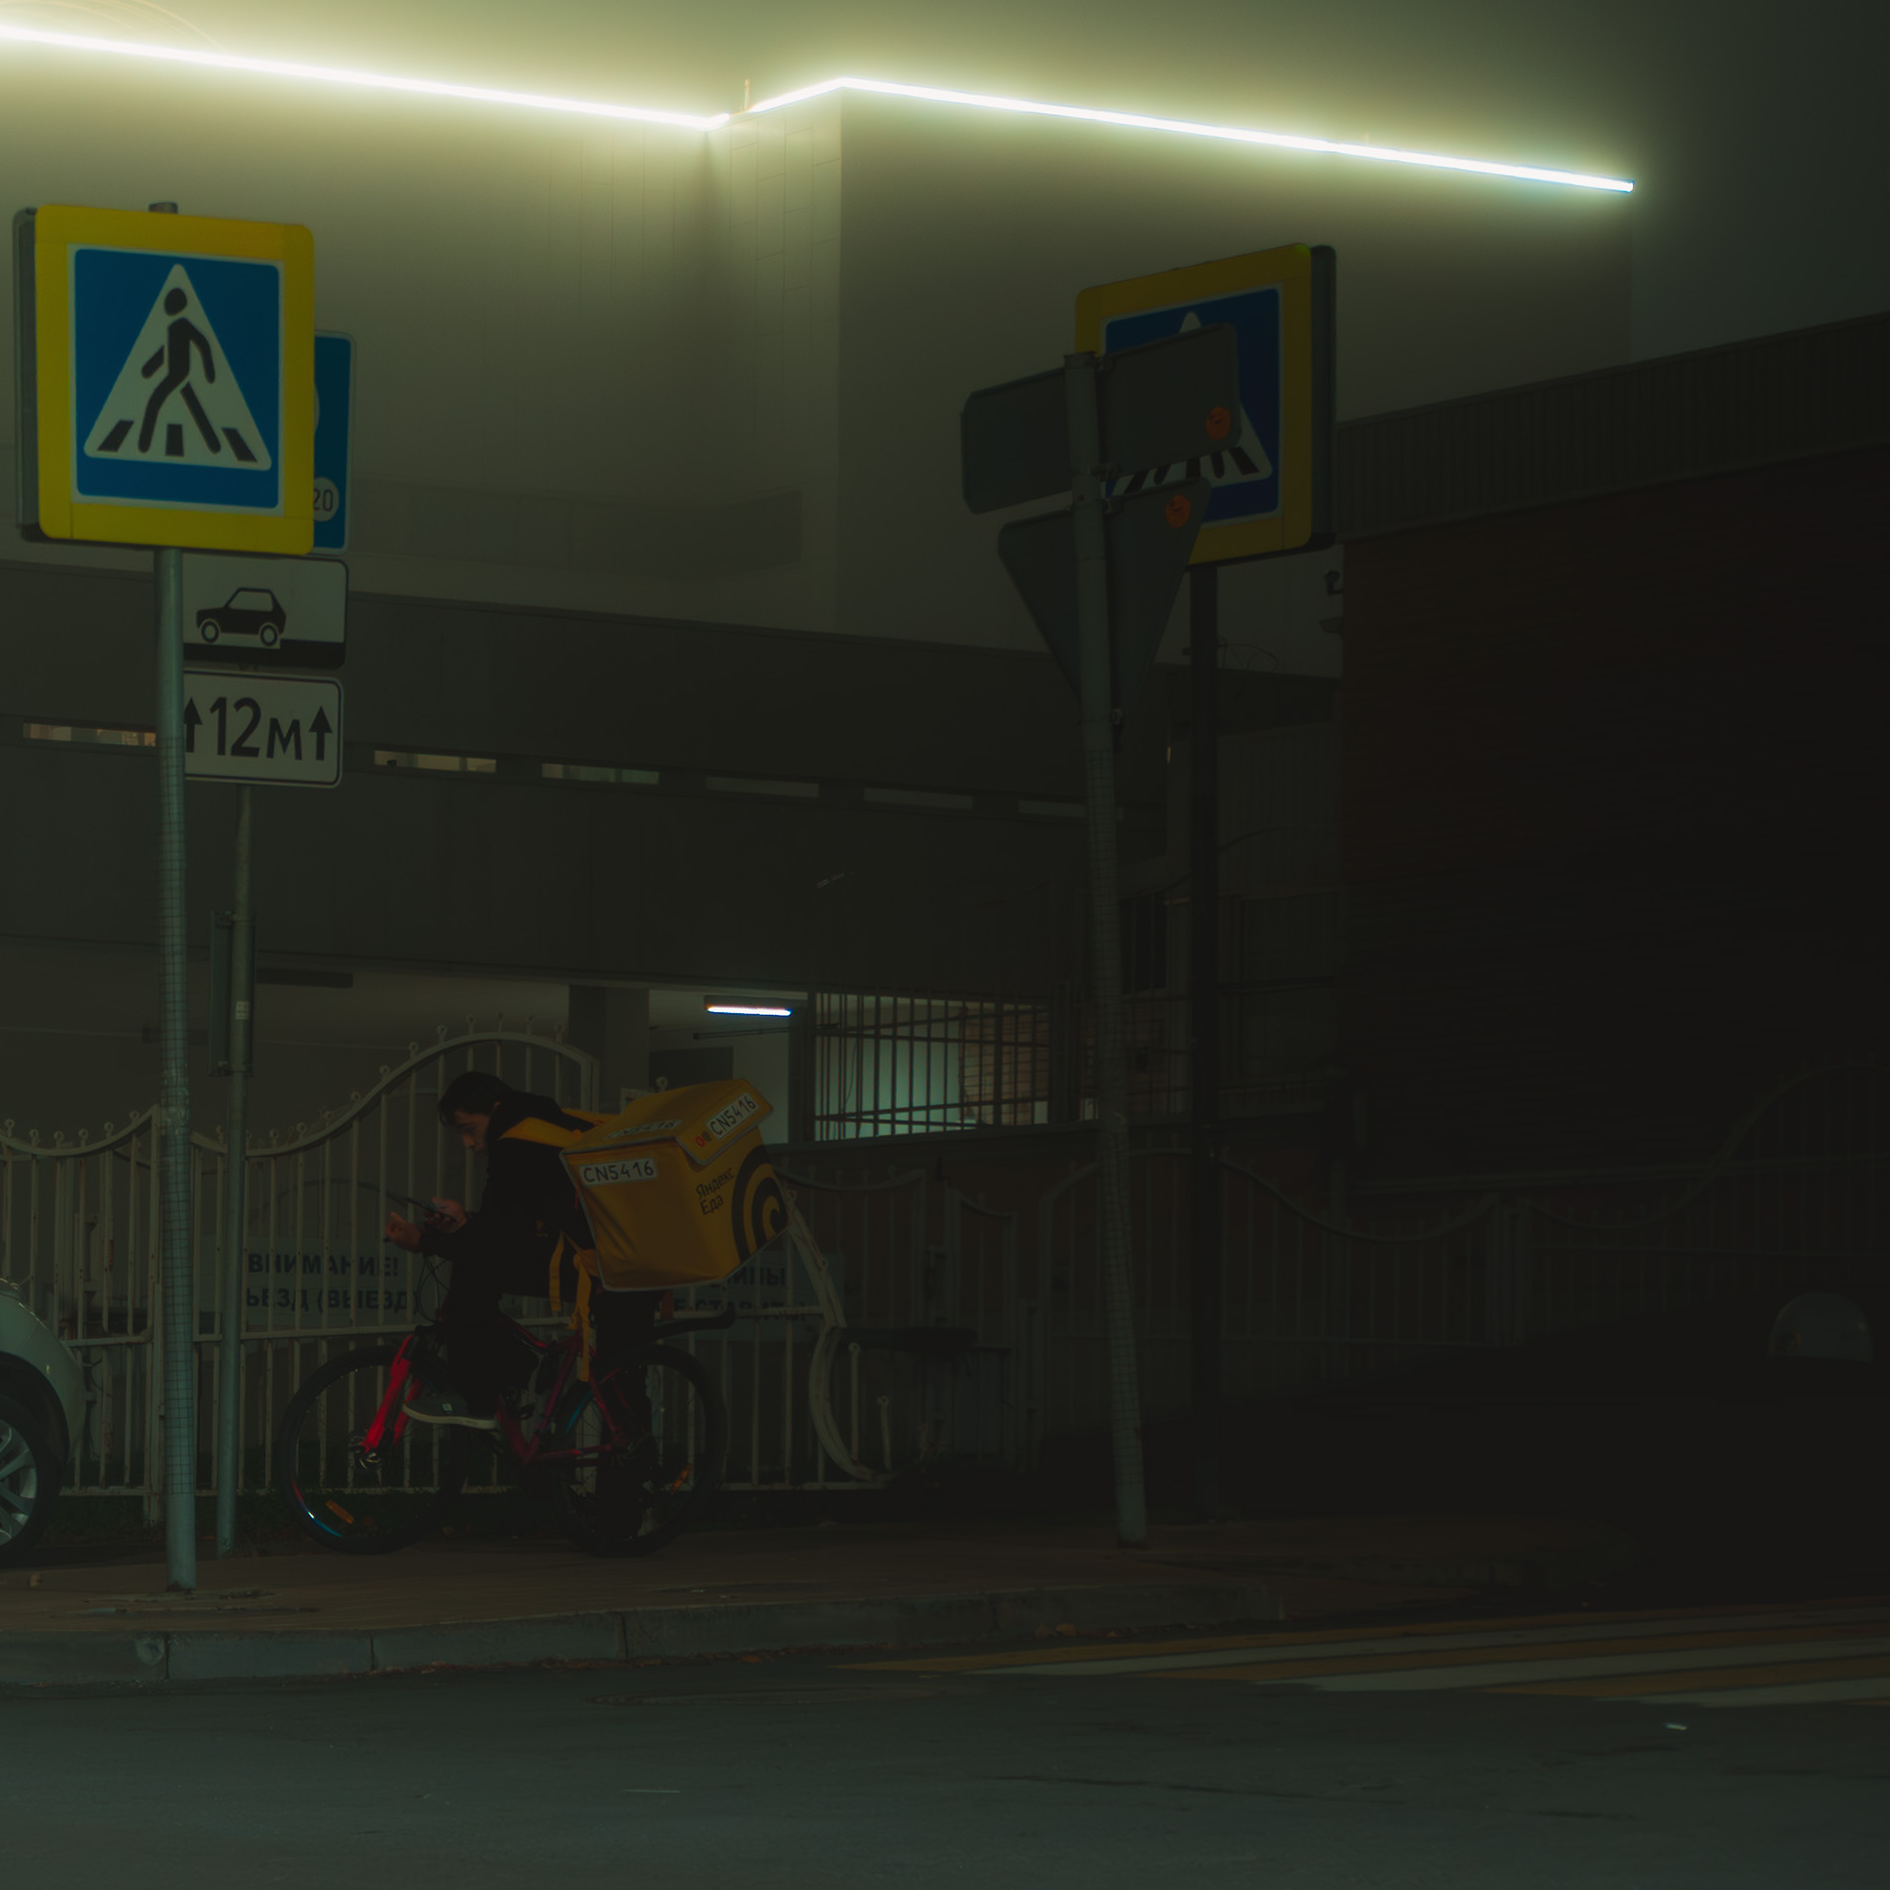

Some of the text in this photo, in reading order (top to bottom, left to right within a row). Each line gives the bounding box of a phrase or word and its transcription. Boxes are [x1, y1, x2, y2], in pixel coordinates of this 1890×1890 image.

[710, 1096, 756, 1135] CN5416
[584, 1161, 654, 1183] CN5416
[695, 1167, 735, 1199] Яндекс
[700, 1194, 724, 1215] Еда
